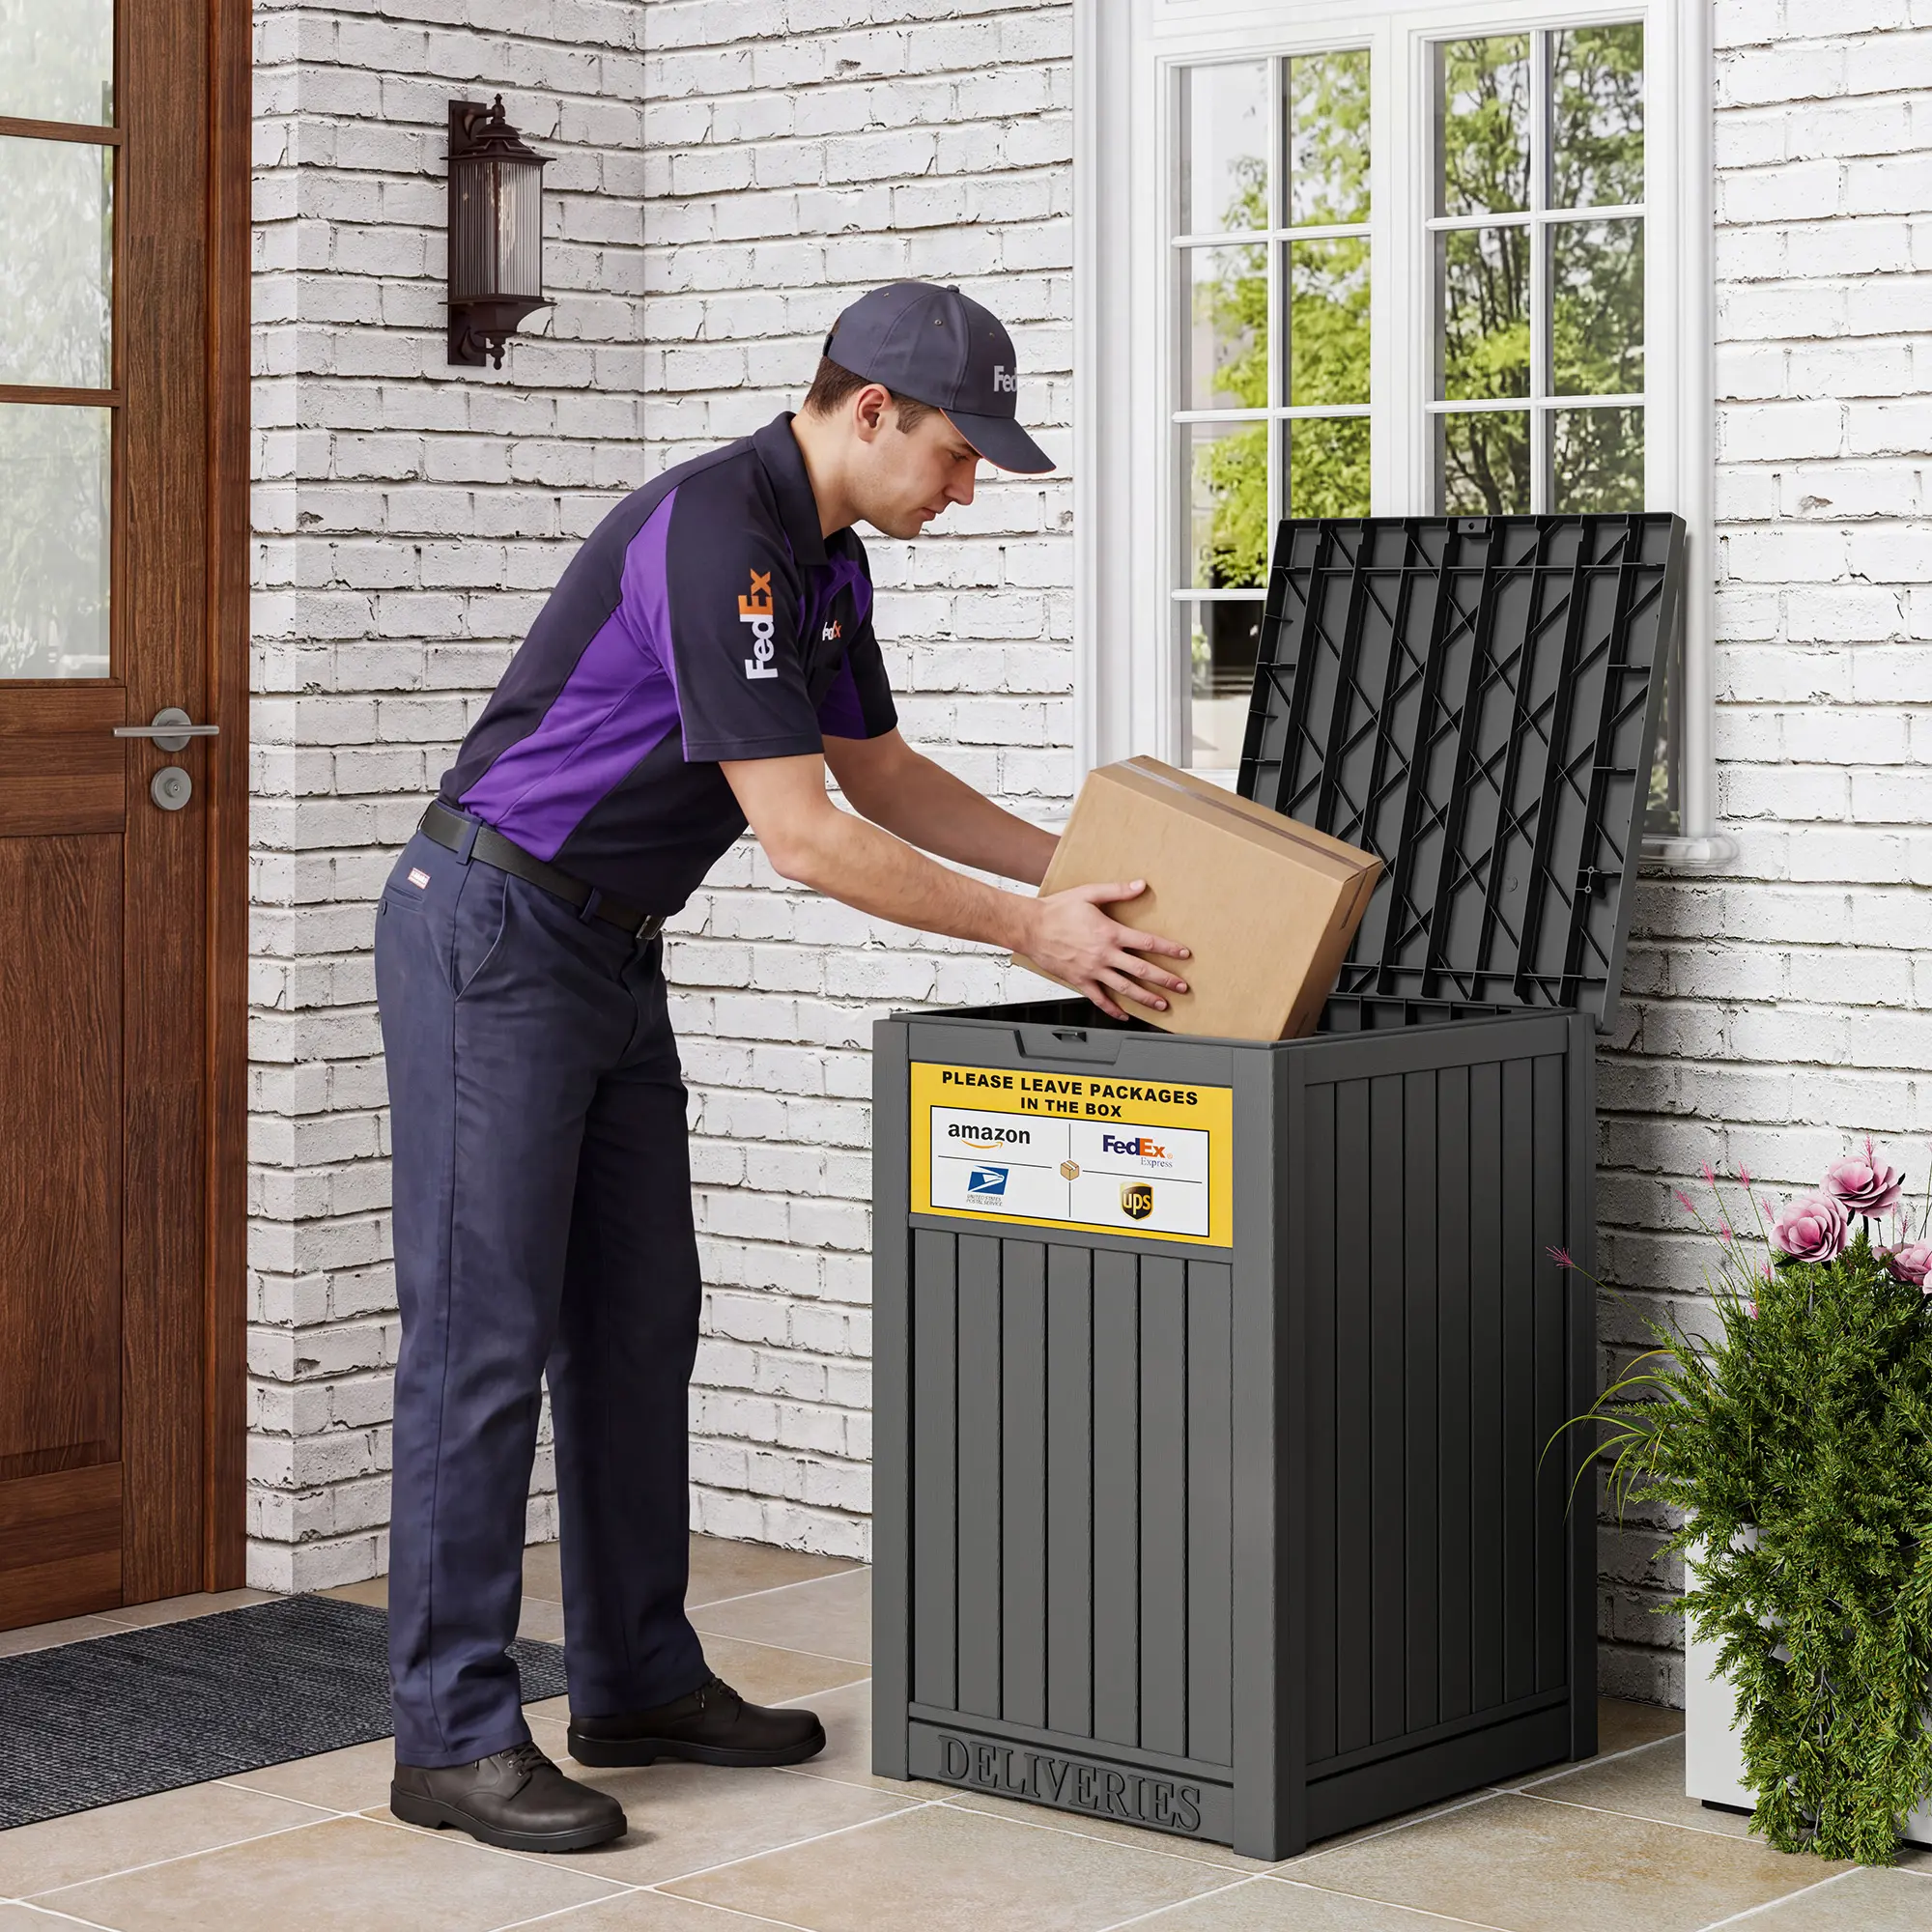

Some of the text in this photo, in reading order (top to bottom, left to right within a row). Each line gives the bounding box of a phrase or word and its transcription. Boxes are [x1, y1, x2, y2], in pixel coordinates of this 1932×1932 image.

[738, 568, 779, 679] FedEx
[942, 1070, 1198, 1106] PLEASE LEAVE PACKAGES
[1020, 1096, 1122, 1118] IN THE BOX
[948, 1122, 1031, 1145] amazon
[1102, 1134, 1166, 1158] FedEx
[1140, 1156, 1173, 1168] Express
[1122, 1193, 1151, 1215] ups
[937, 1734, 1202, 1833] DELIVERIES
